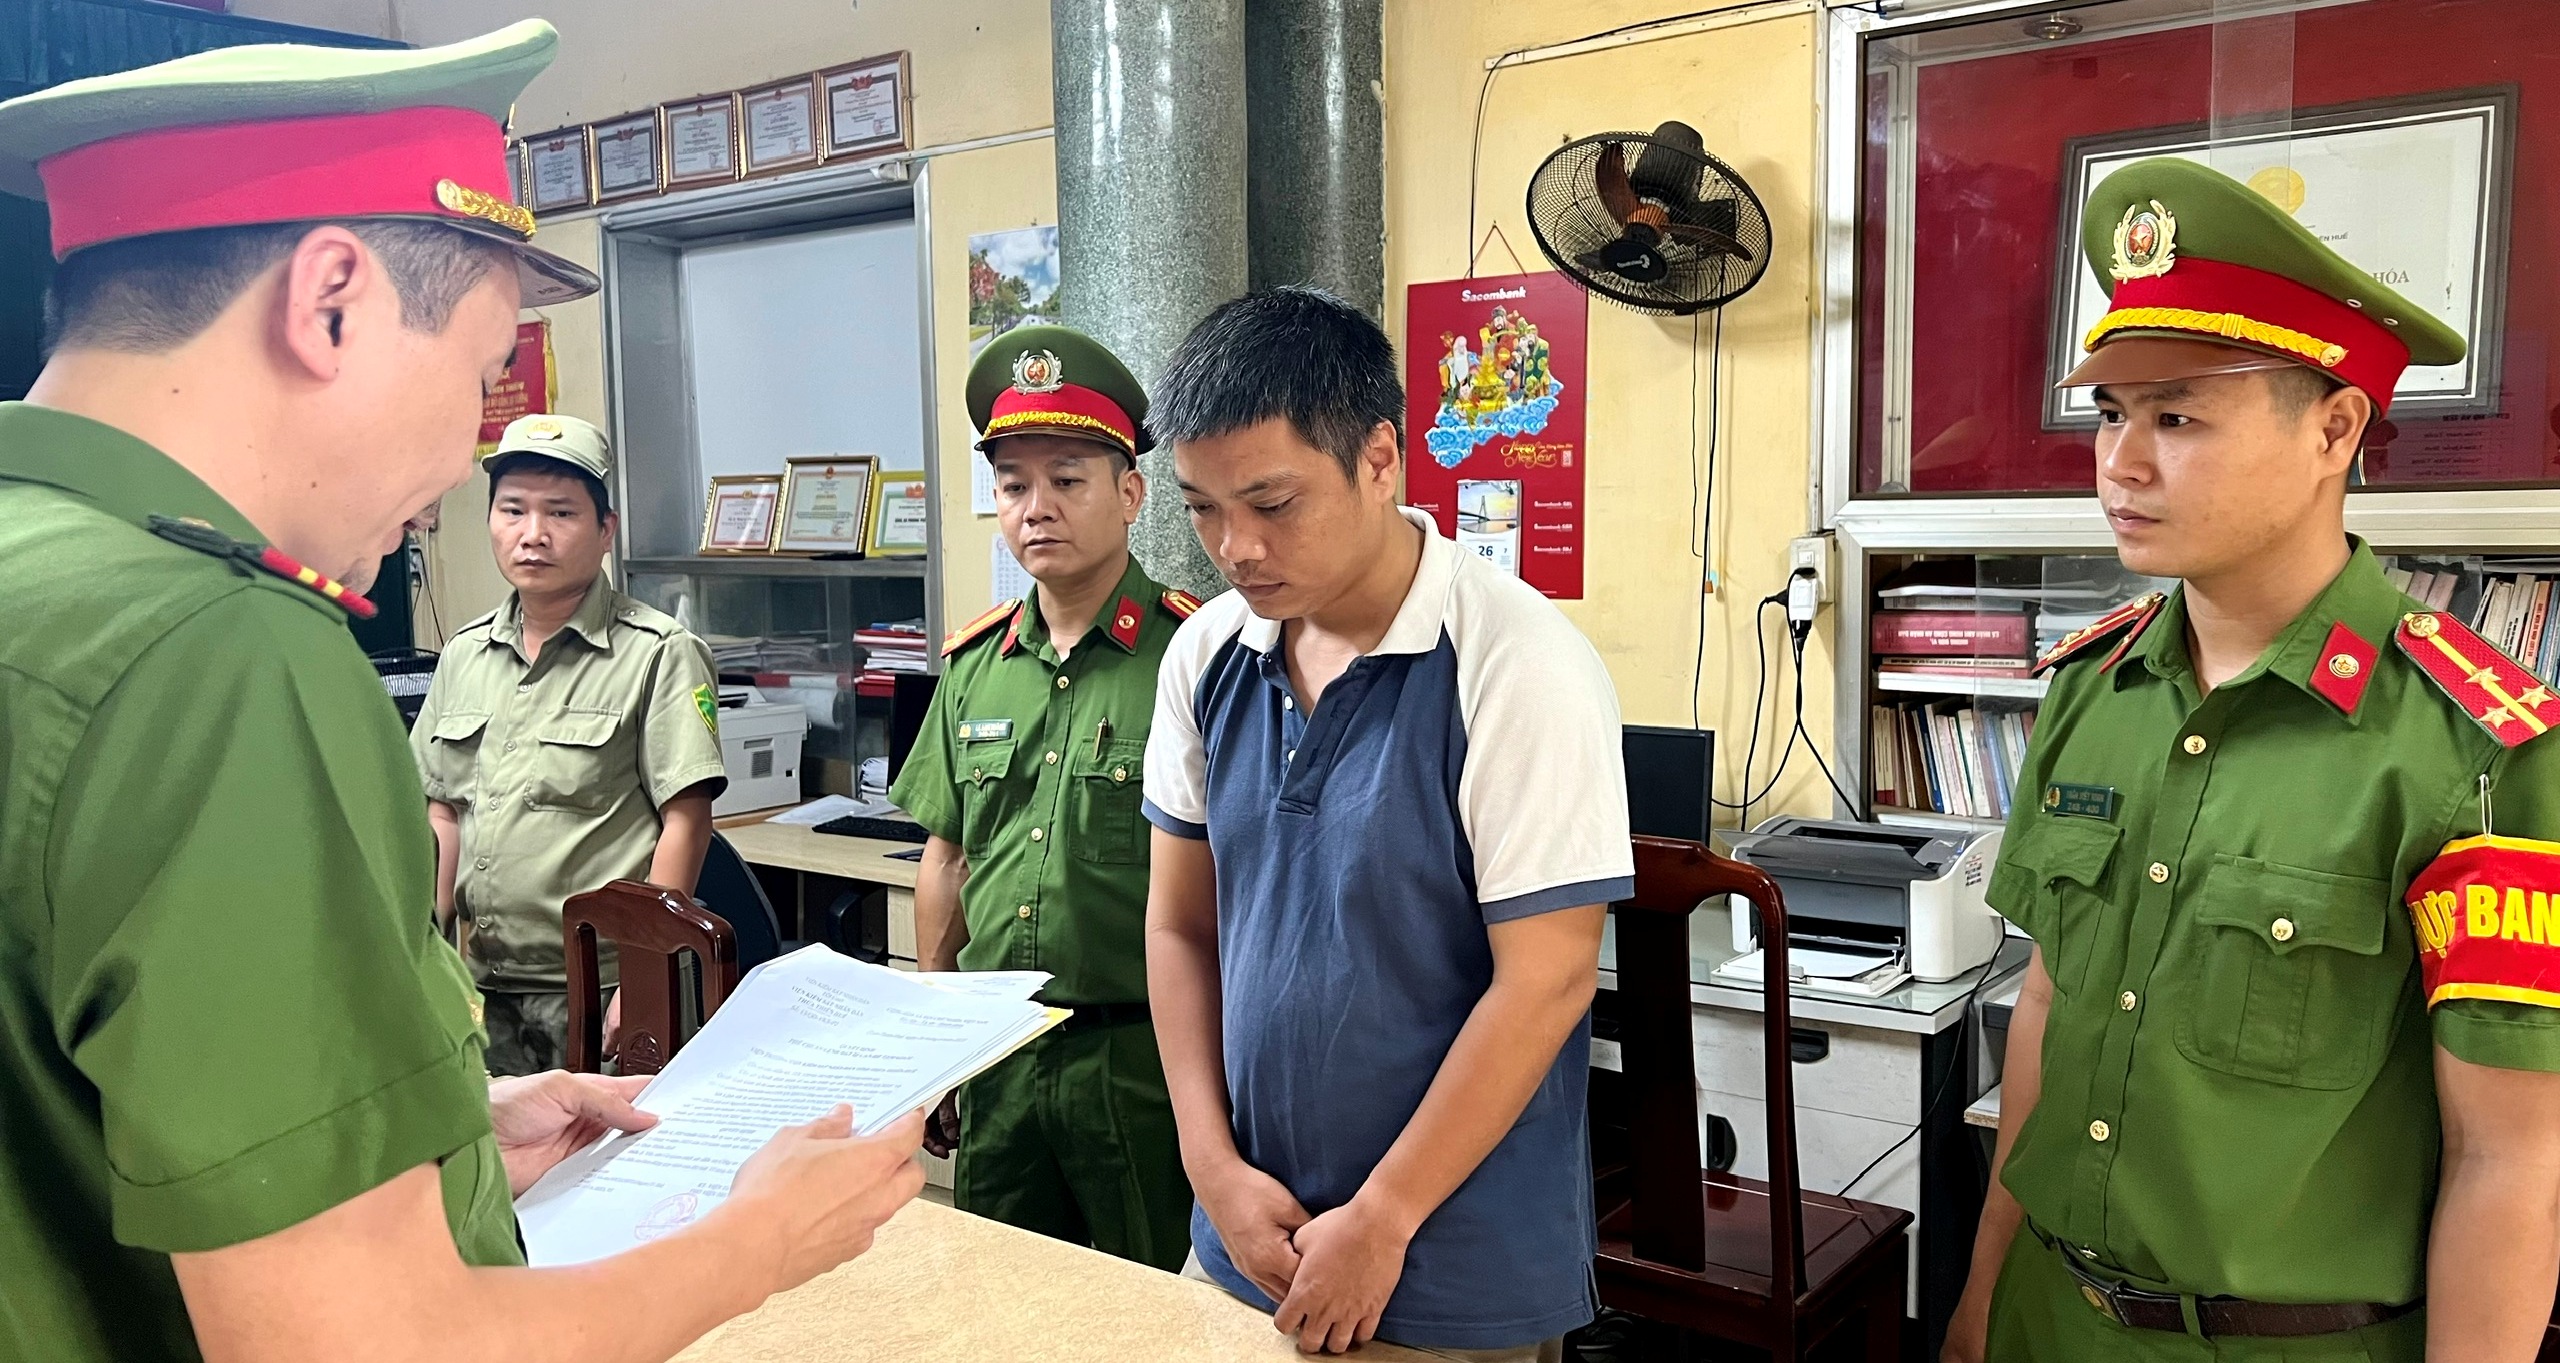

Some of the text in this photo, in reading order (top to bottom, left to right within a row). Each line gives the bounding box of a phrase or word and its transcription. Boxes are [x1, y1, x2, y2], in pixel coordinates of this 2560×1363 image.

[2373, 267, 2410, 285] HÓA
[1461, 286, 1526, 302] Sacombank
[1478, 545, 1494, 557] 26
[2466, 884, 2560, 947] BAN
